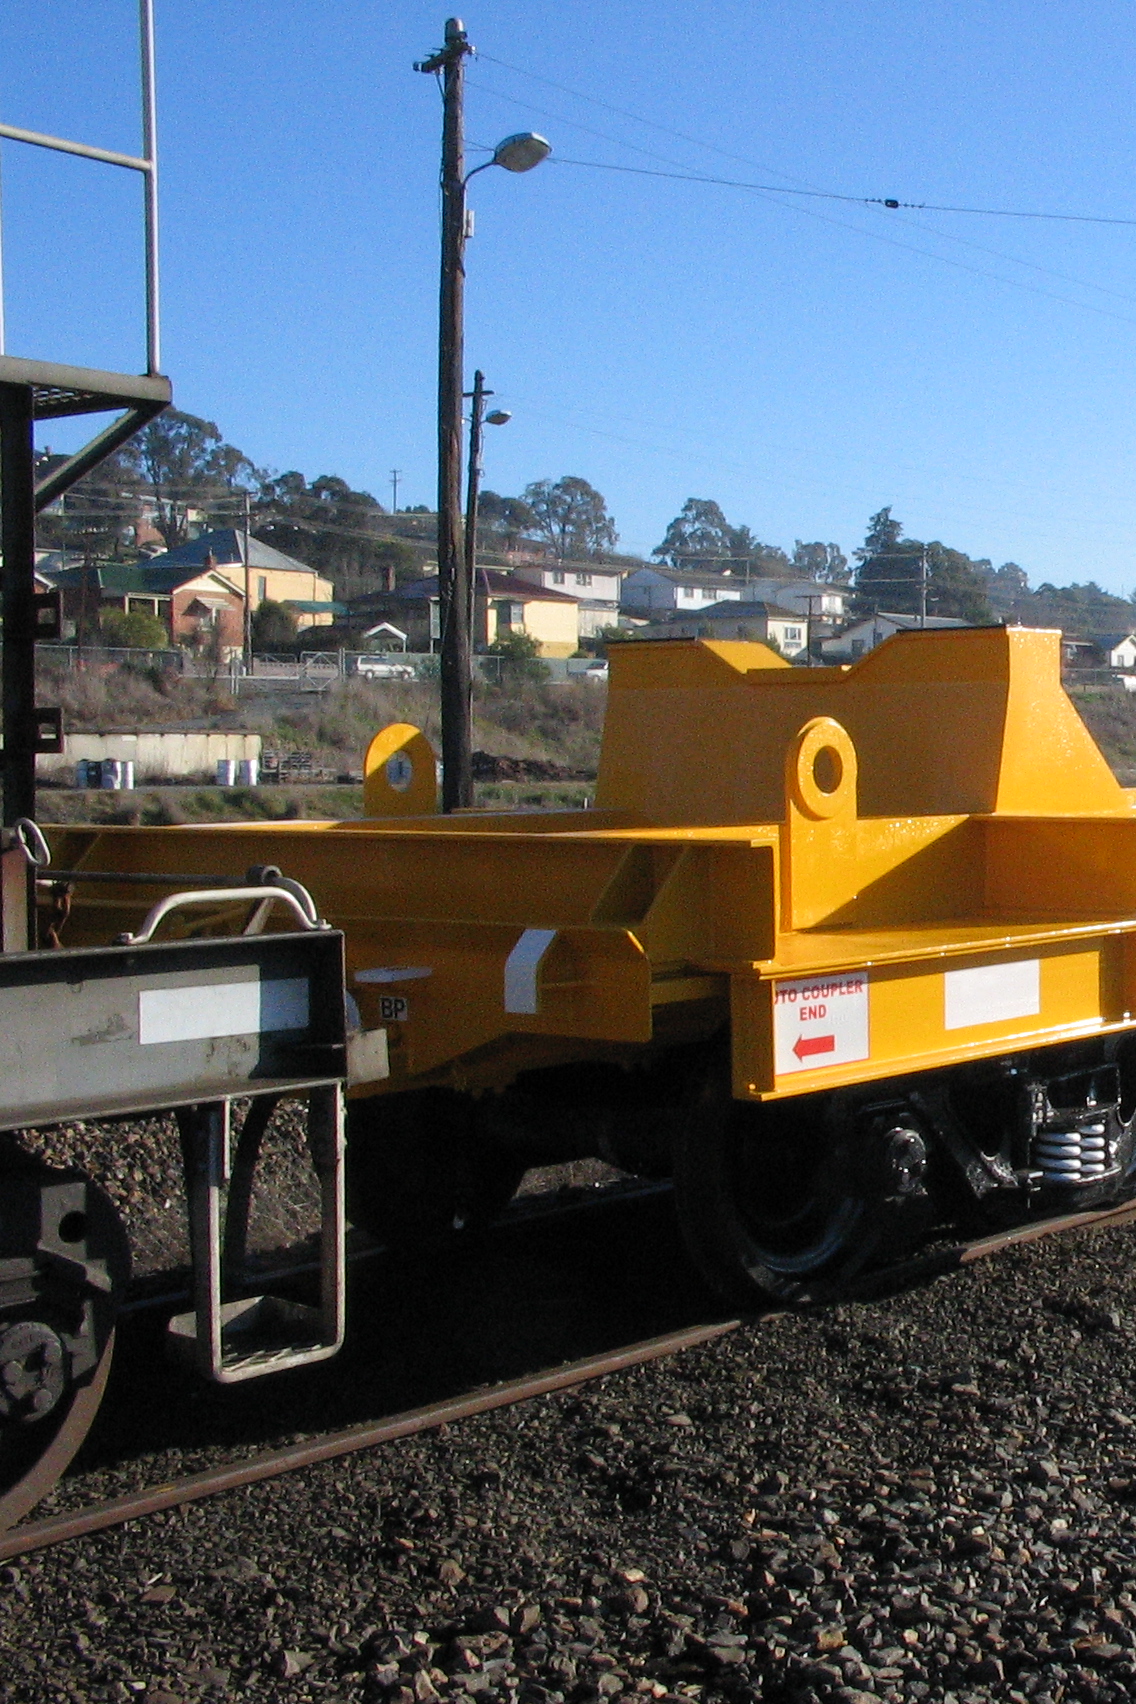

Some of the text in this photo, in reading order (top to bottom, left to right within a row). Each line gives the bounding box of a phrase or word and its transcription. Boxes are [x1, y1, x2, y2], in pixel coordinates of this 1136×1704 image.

[803, 979, 863, 1001] COUPLER
[381, 998, 405, 1019] BP
[799, 1004, 827, 1022] END
